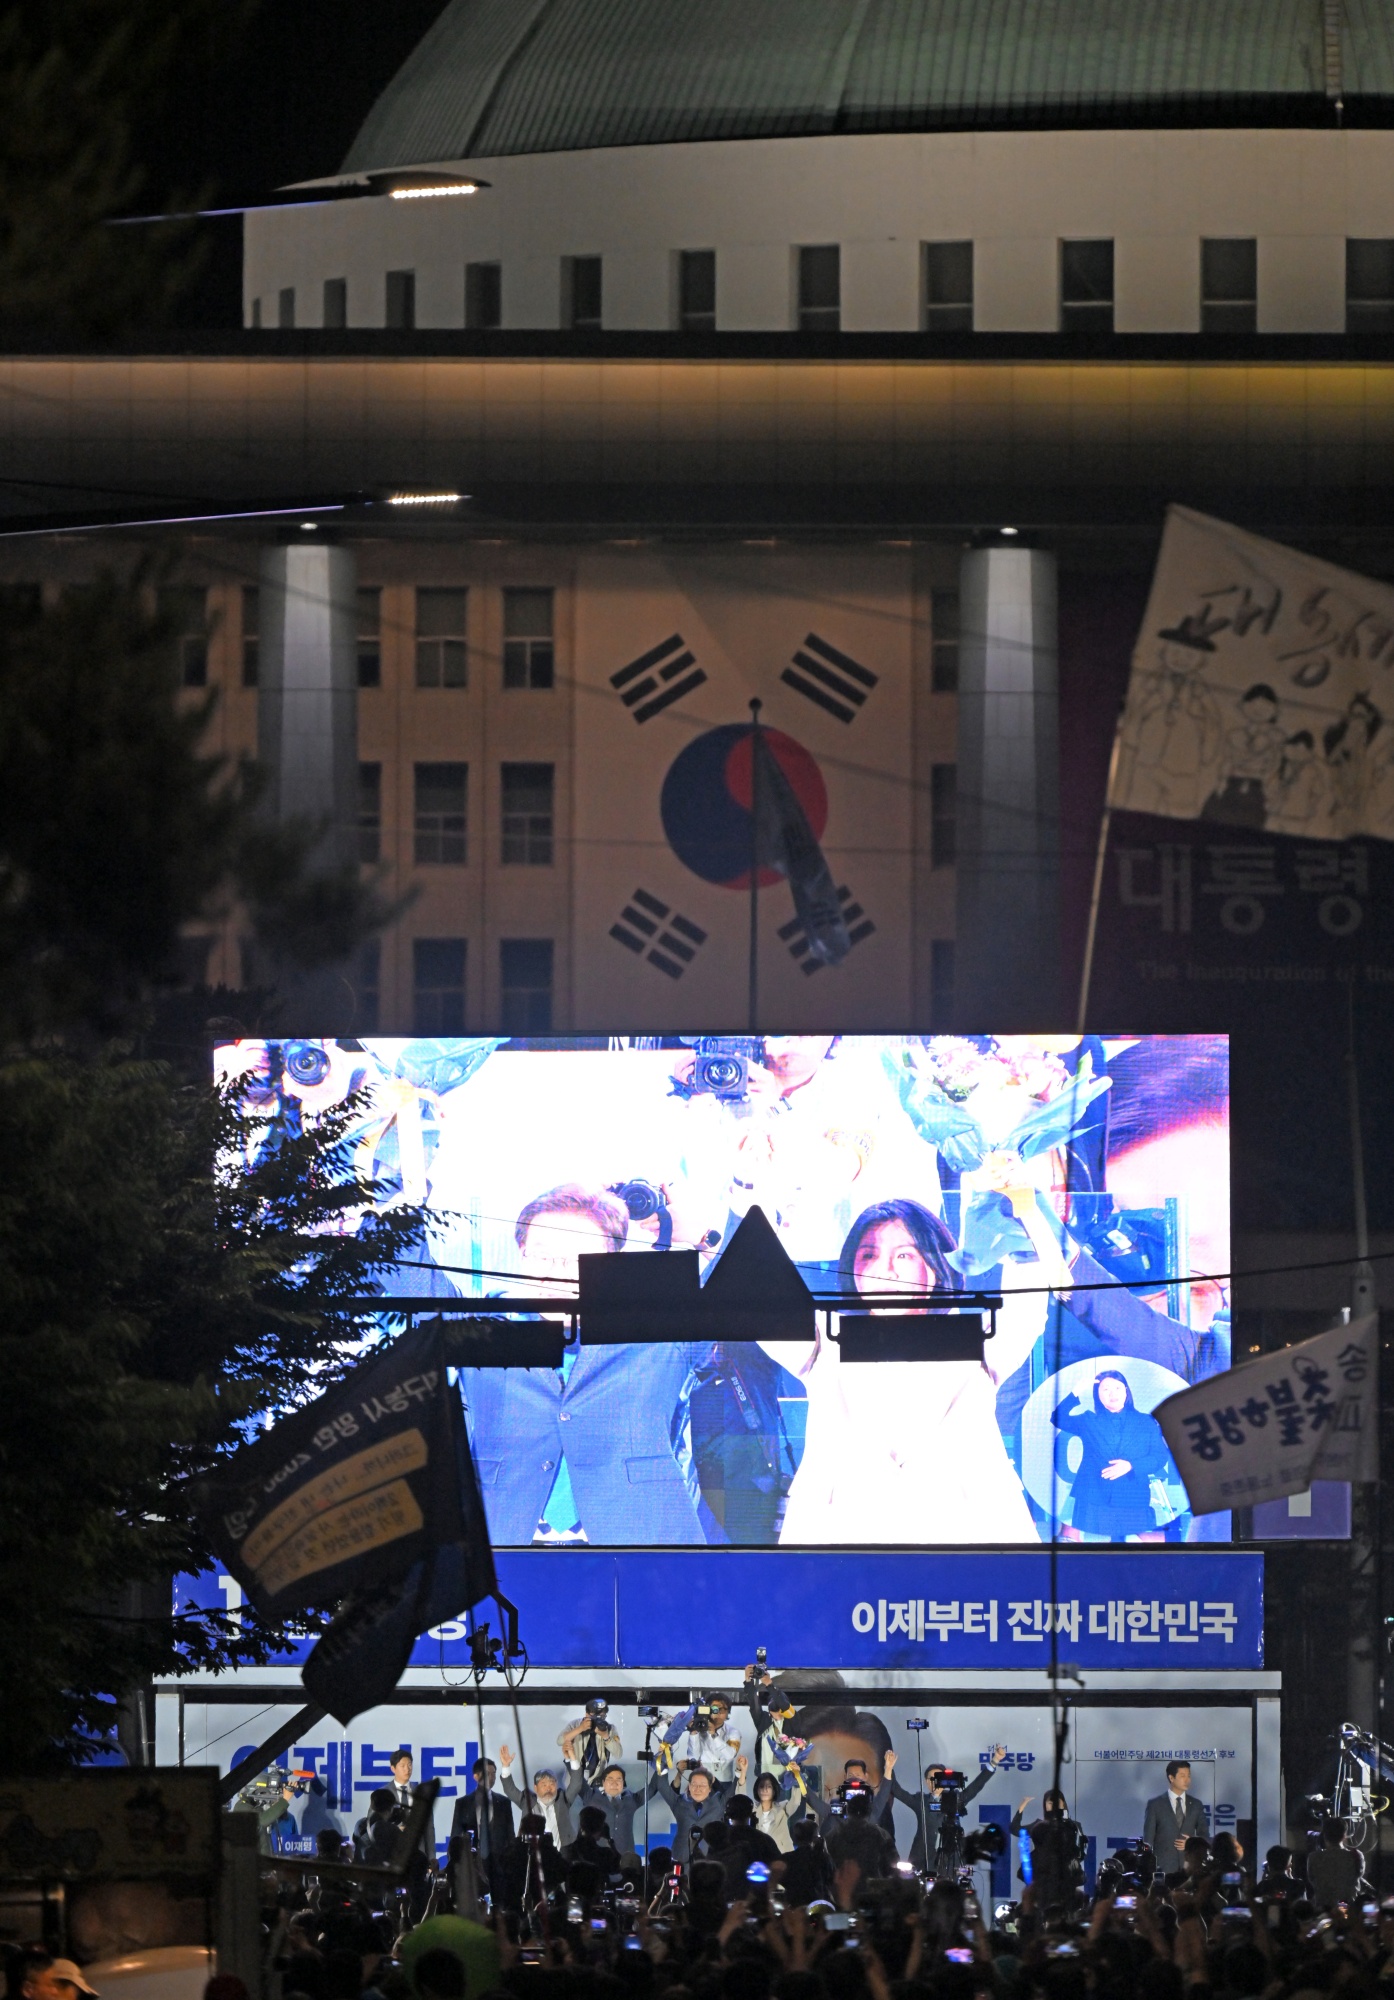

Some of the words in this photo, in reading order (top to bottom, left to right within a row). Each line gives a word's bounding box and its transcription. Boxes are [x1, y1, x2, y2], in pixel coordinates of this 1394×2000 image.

[1114, 843, 1370, 936] 대통령
[851, 1598, 998, 1643] 이제부터
[1006, 1599, 1083, 1643] 진짜
[1088, 1600, 1238, 1644] 대한민국
[1094, 1749, 1144, 1760] 더불어민주당
[1146, 1749, 1173, 1760] 제21대
[1174, 1749, 1217, 1760] 대통령선거
[1219, 1749, 1236, 1760] 후보
[284, 1840, 313, 1852] 이재명
